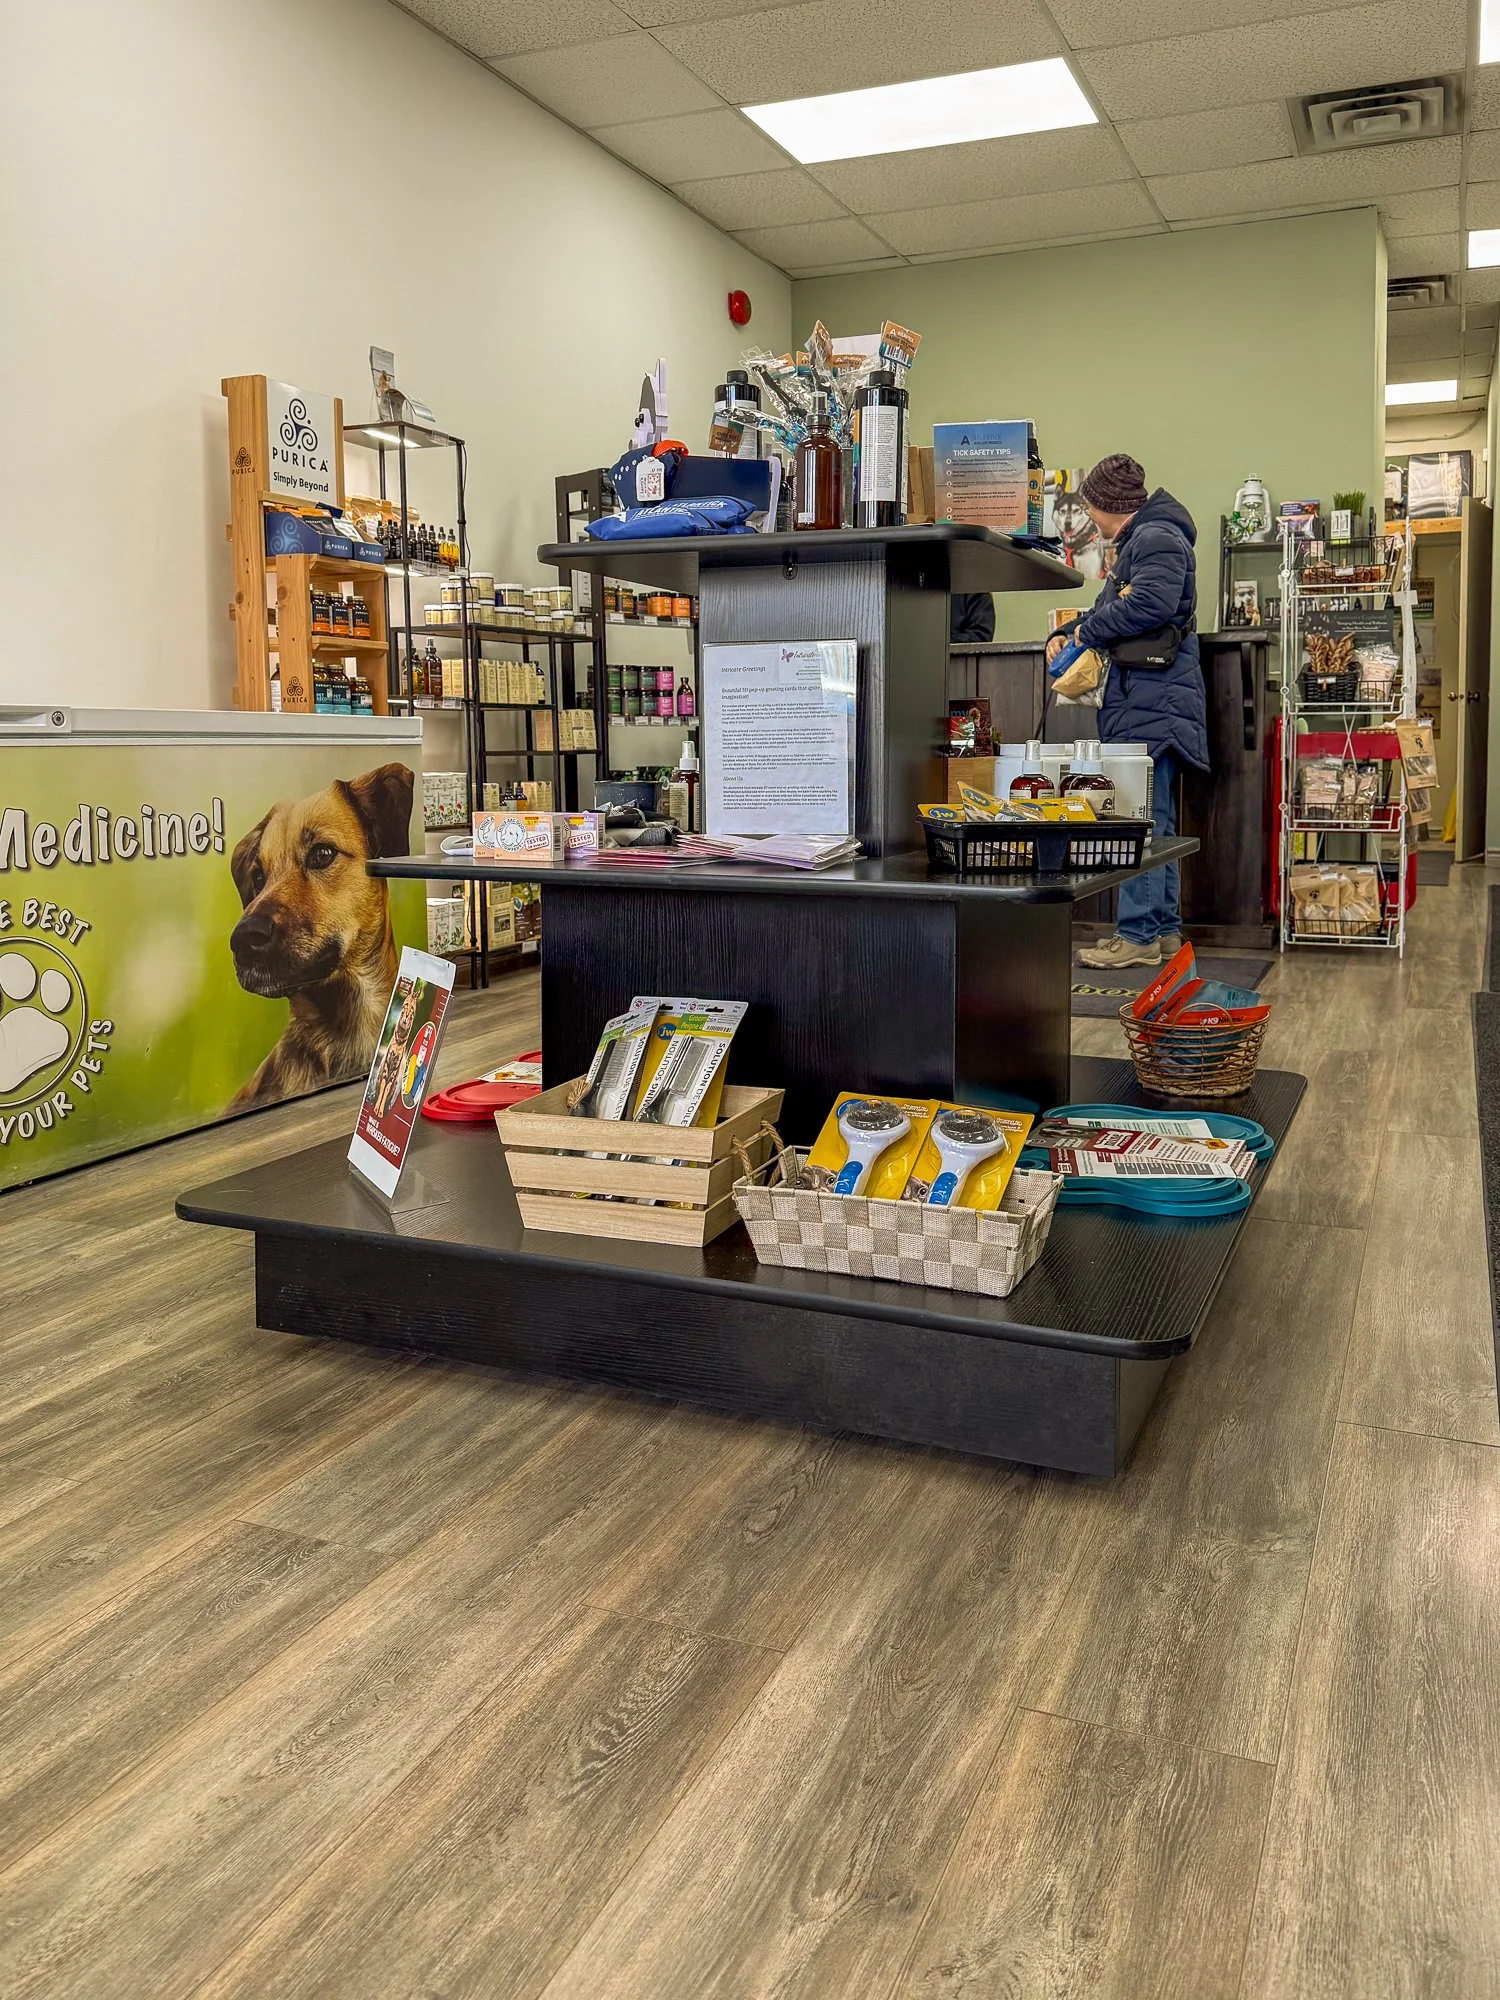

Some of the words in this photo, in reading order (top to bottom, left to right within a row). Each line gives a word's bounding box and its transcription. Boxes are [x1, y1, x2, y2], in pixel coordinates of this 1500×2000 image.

[272, 446, 329, 472] PURICA
[953, 449, 969, 457] TICK
[969, 448, 995, 456] SAFETY
[996, 447, 1011, 455] TIPS
[231, 467, 256, 475] PURICA
[273, 471, 298, 489] Simply
[299, 478, 329, 492] Beyond
[0, 797, 225, 870] Medicine!
[526, 836, 547, 846] TESTED
[570, 834, 592, 844] TESTED
[22, 898, 90, 944] BEST
[1207, 1017, 1219, 1025] K9
[655, 1040, 679, 1082] SOLUTION
[699, 1042, 726, 1090] SOLUTION
[0, 1090, 73, 1145] YOUR
[70, 1019, 114, 1093] PETS
